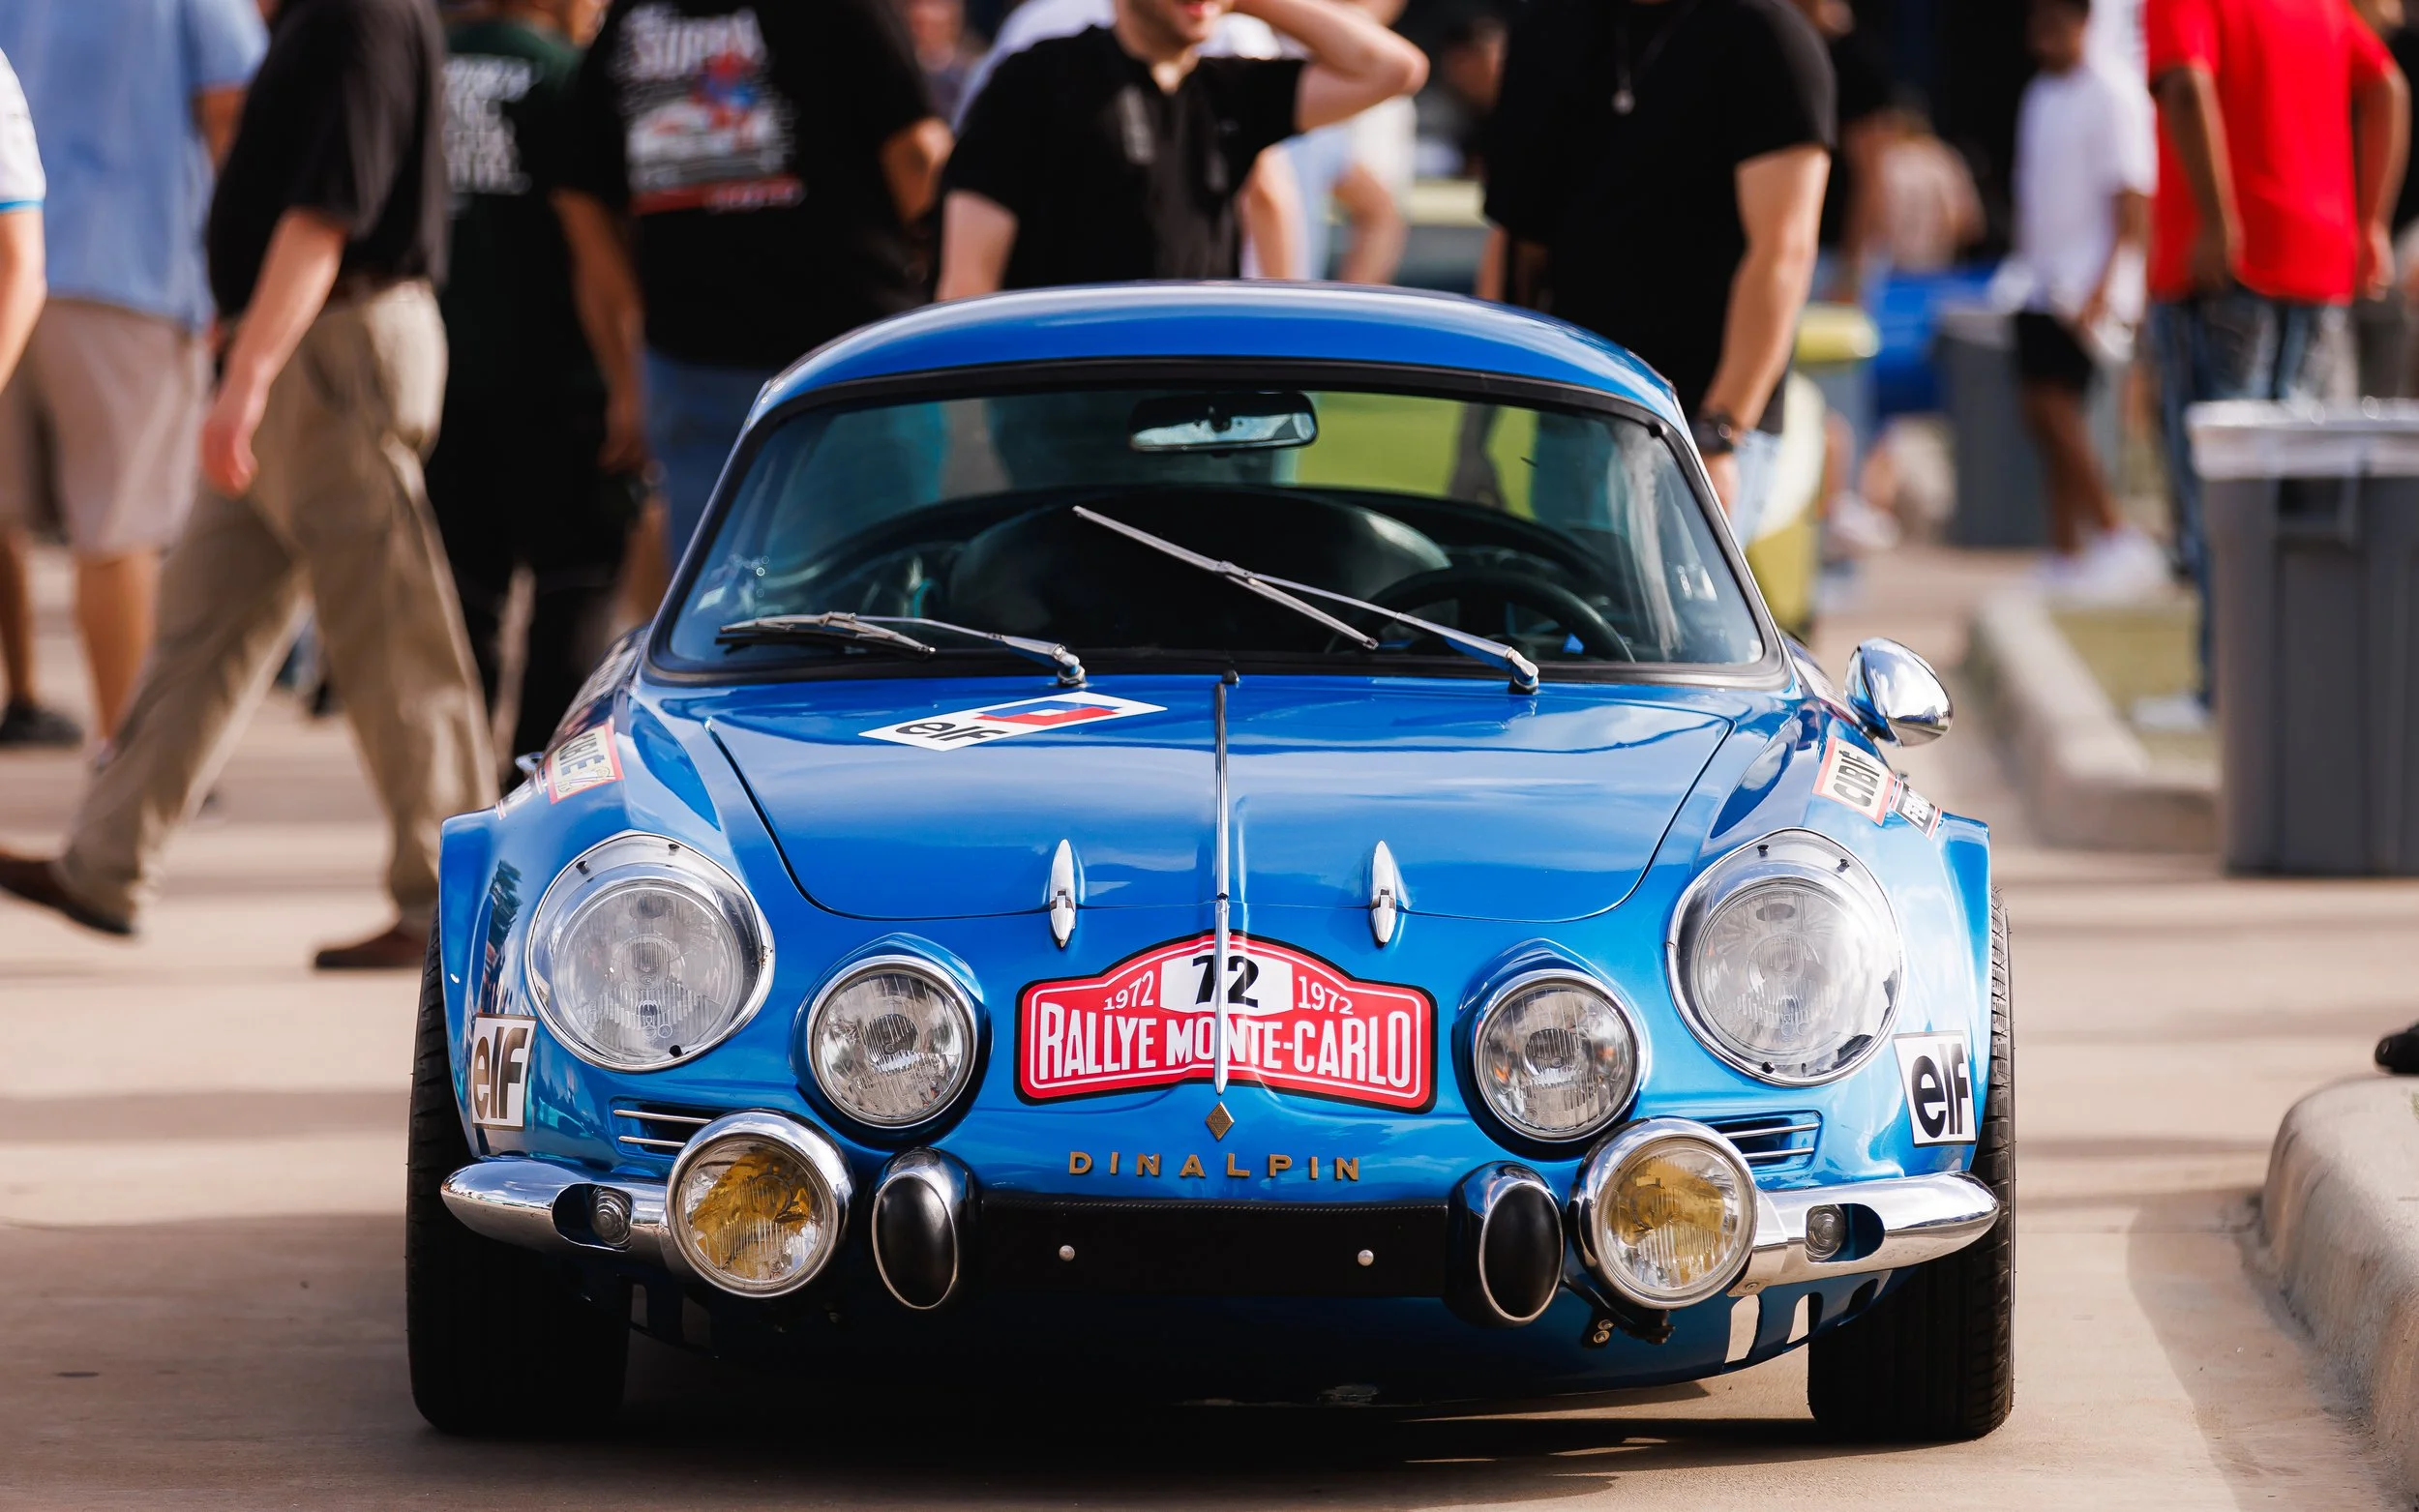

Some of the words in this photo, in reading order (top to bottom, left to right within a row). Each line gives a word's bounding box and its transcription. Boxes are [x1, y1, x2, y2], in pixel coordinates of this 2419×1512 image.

[895, 722, 1009, 741] elf
[1103, 969, 1154, 1011] 1972
[1192, 954, 1260, 1009] 72
[1298, 975, 1354, 1016] 1972
[1039, 1001, 1157, 1081] RALLYE
[1166, 1010, 1412, 1088] MONTE-CARLO
[472, 1025, 529, 1120] elf
[1911, 1043, 1969, 1139] elf
[1068, 1150, 1359, 1181] DINALPIN
